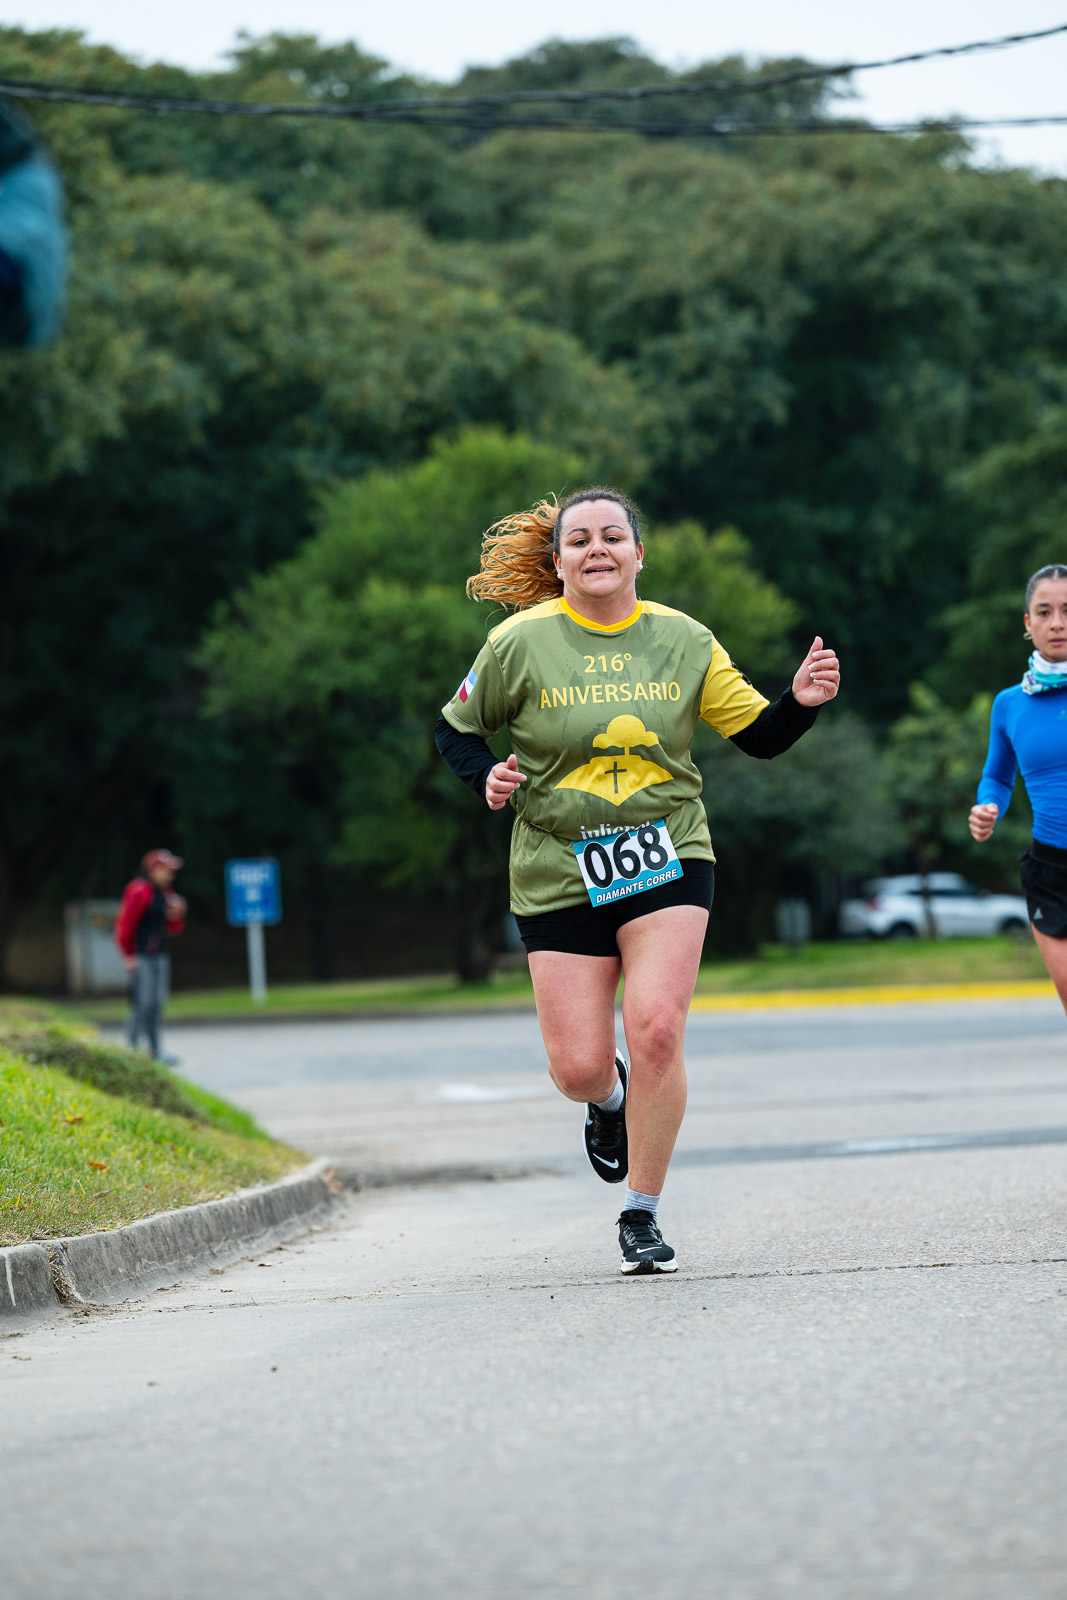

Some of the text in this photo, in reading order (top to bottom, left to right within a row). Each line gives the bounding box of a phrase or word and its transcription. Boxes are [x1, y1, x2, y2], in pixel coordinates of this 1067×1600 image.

[583, 652, 633, 673] 216°
[540, 682, 681, 709] ANIVERSARIO
[583, 824, 669, 889] 068
[596, 868, 678, 904] DIAMANTE CORRE
